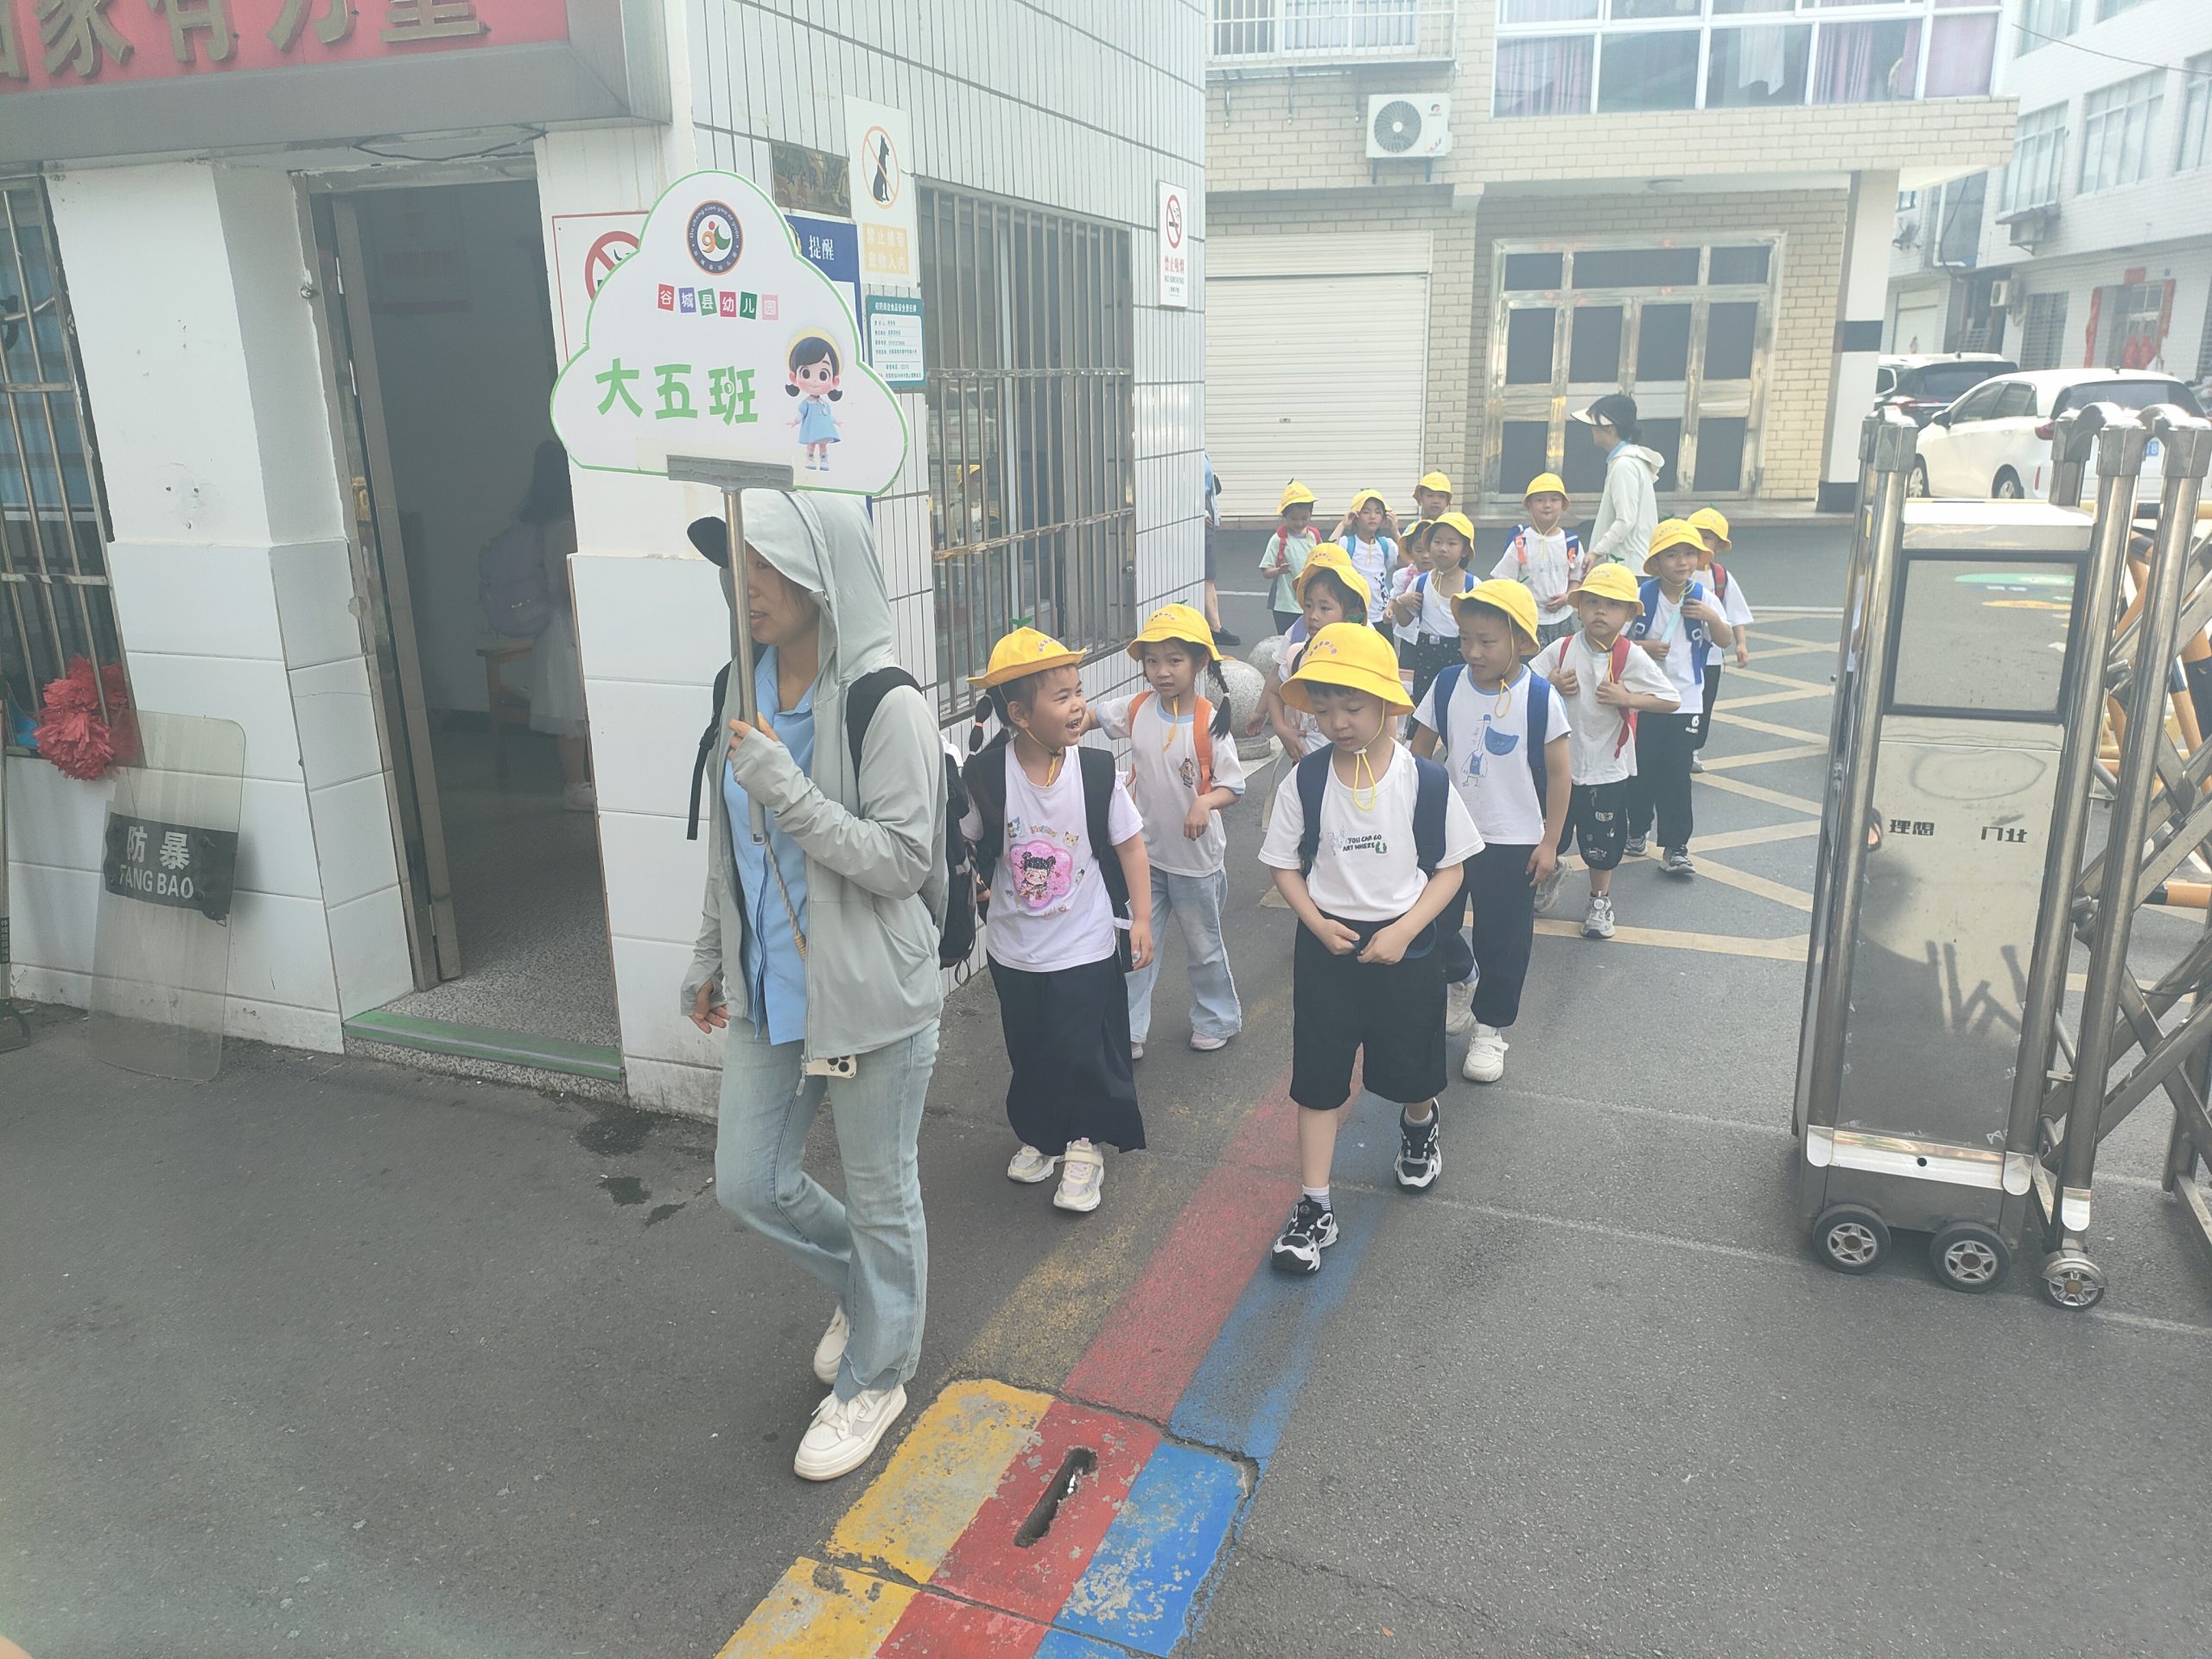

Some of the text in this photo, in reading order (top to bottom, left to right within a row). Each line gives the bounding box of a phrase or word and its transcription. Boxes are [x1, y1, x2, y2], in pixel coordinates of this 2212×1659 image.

[809, 235, 835, 261] 提醒
[660, 289, 776, 315] 谷城县幼儿园
[595, 357, 759, 426] 大五班
[126, 825, 191, 870] 防暴
[157, 873, 194, 899] BAO
